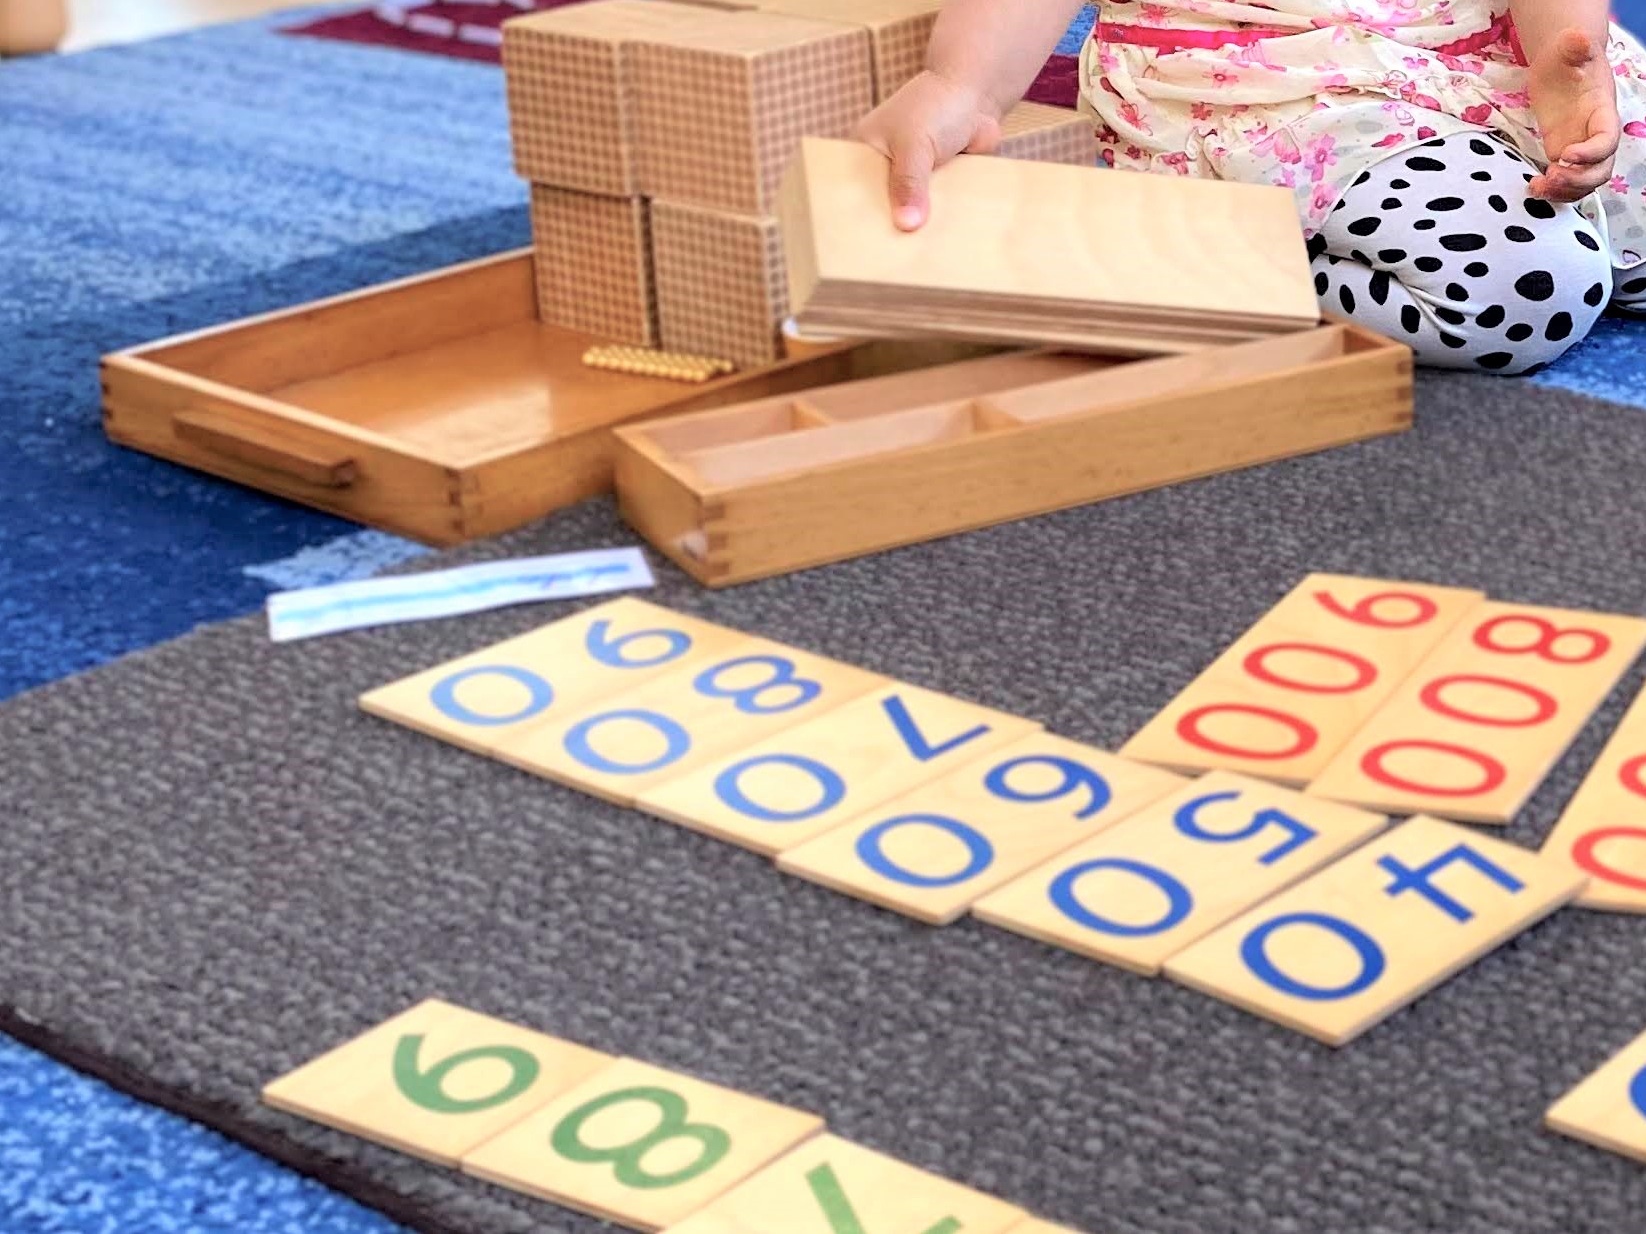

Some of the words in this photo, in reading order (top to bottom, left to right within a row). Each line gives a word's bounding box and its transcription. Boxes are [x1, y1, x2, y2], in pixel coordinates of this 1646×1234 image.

[429, 619, 693, 726] 90
[563, 655, 822, 774] 80
[1174, 589, 1440, 763] 900
[1358, 612, 1612, 800] 800
[713, 694, 992, 822] 70
[854, 753, 1114, 888] 60
[1047, 790, 1318, 938] 50
[1239, 842, 1526, 1002] 40
[391, 1034, 541, 1114] 9
[550, 1084, 730, 1189] 8
